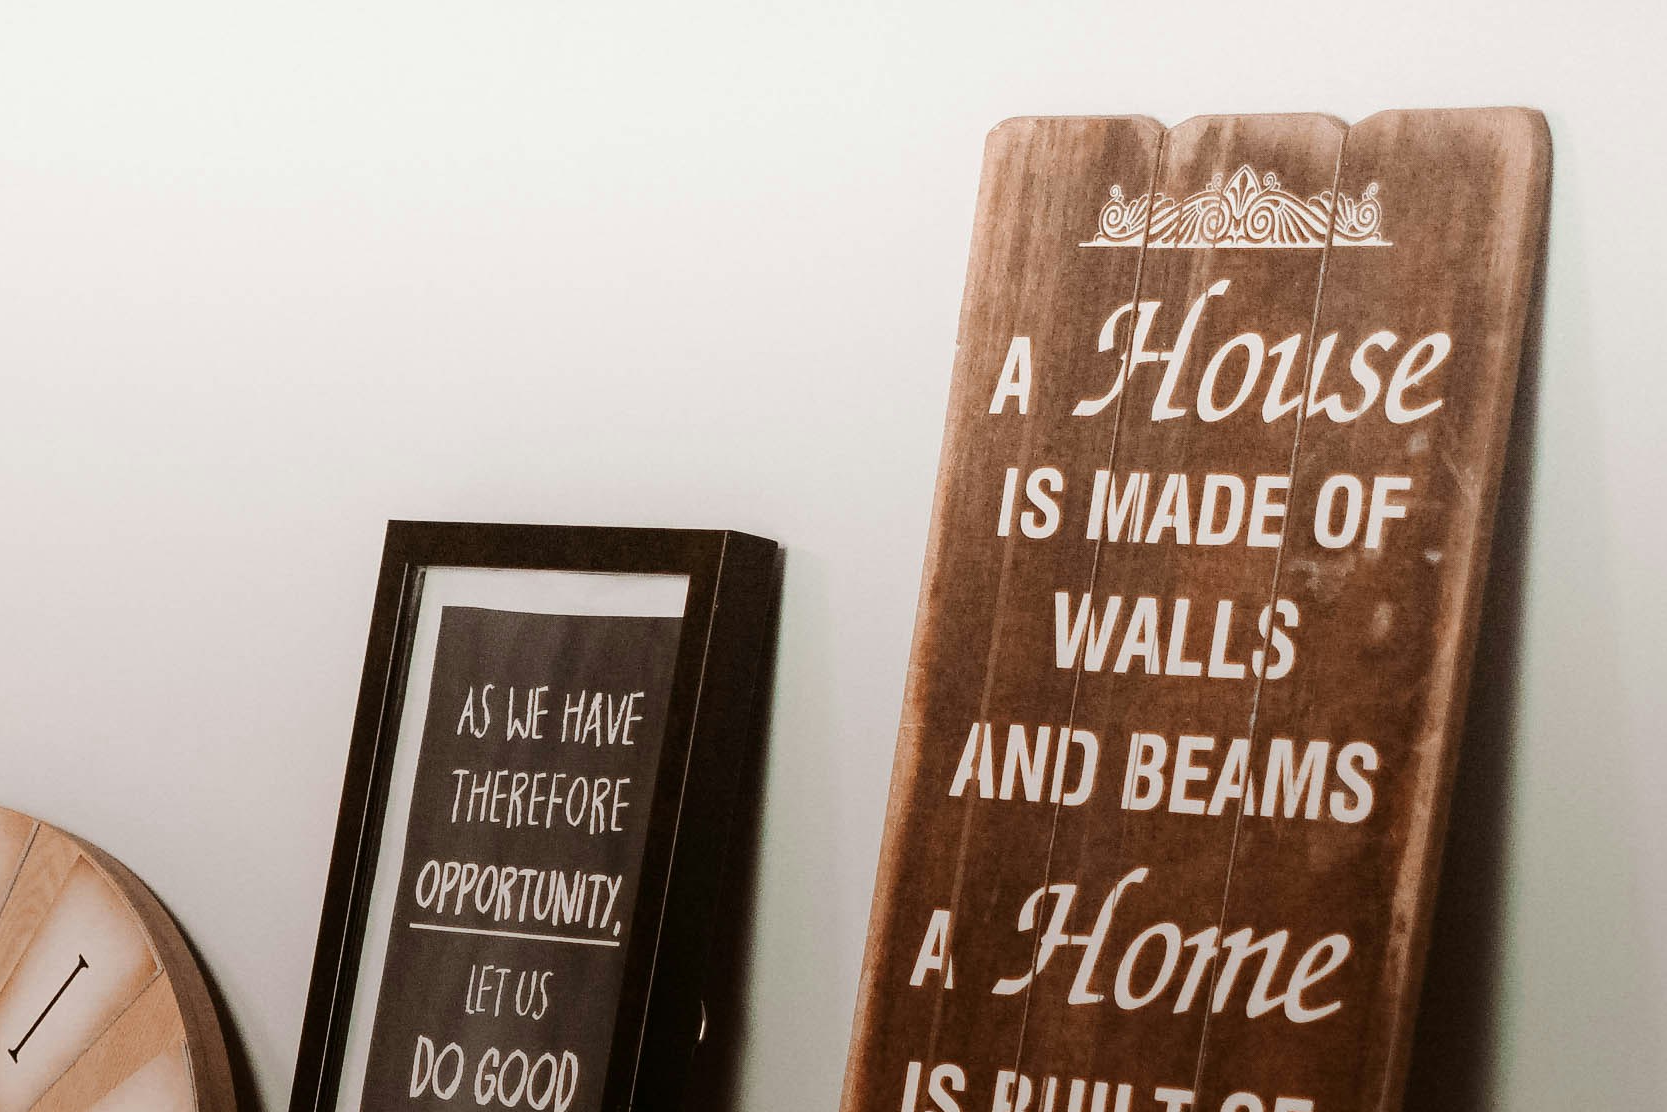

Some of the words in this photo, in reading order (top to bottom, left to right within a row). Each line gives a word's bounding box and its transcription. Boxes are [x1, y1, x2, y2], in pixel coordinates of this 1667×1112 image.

[988, 336, 1032, 415] A
[1071, 279, 1452, 424] House
[996, 467, 1063, 540] IS
[1086, 470, 1289, 548] MADE
[1313, 475, 1413, 549] OF
[1054, 591, 1300, 680] WALLS
[456, 684, 495, 739] AS
[506, 685, 550, 741] WE
[561, 691, 645, 746] HAVE
[450, 769, 631, 835] THEREFORE
[948, 722, 1100, 807] AND
[1120, 731, 1379, 824] BEAMS
[415, 860, 622, 936] OPPORTUNITY,
[909, 909, 954, 990] A
[991, 867, 1352, 1024] Home
[8, 954, 90, 1064] I
[464, 964, 511, 1015] LET
[515, 970, 554, 1021] US
[409, 1034, 464, 1100] DO
